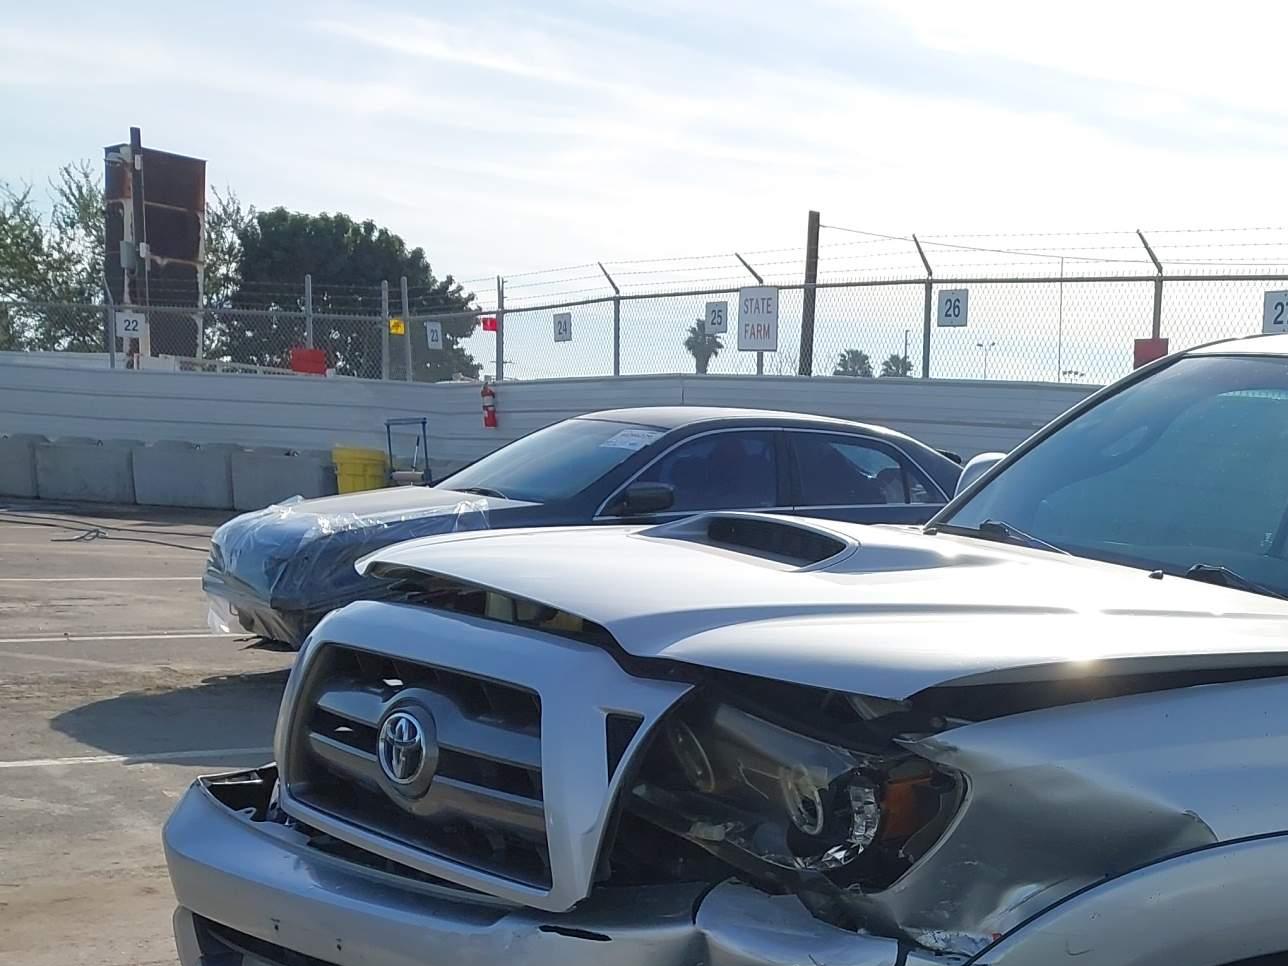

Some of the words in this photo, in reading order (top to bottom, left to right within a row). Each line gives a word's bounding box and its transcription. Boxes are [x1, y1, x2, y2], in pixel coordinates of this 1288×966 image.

[743, 297, 773, 315] STATE
[943, 297, 961, 318] 26
[123, 319, 139, 332] 22
[710, 309, 723, 326] 25
[557, 320, 567, 335] 24
[744, 322, 771, 341] FARM
